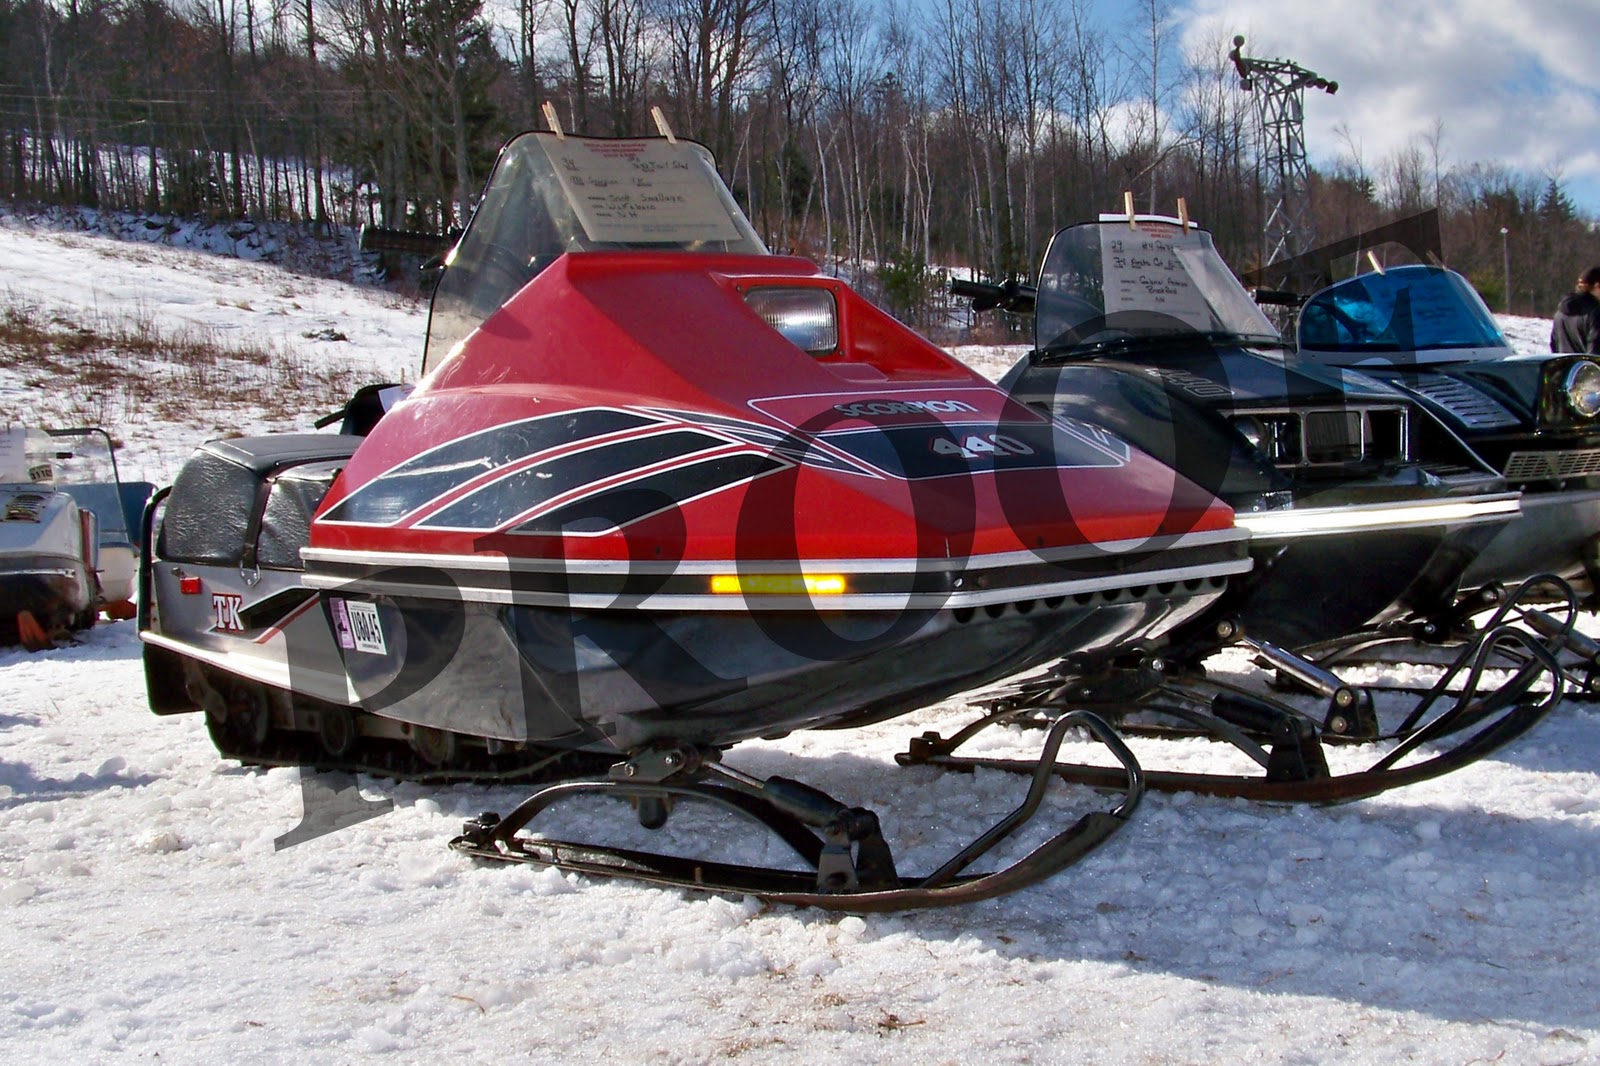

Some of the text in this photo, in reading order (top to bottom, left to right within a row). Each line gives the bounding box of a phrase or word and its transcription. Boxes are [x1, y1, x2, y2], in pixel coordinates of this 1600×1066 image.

[833, 399, 979, 418] SCORPION
[931, 433, 1036, 459] 440
[212, 592, 245, 633] TK
